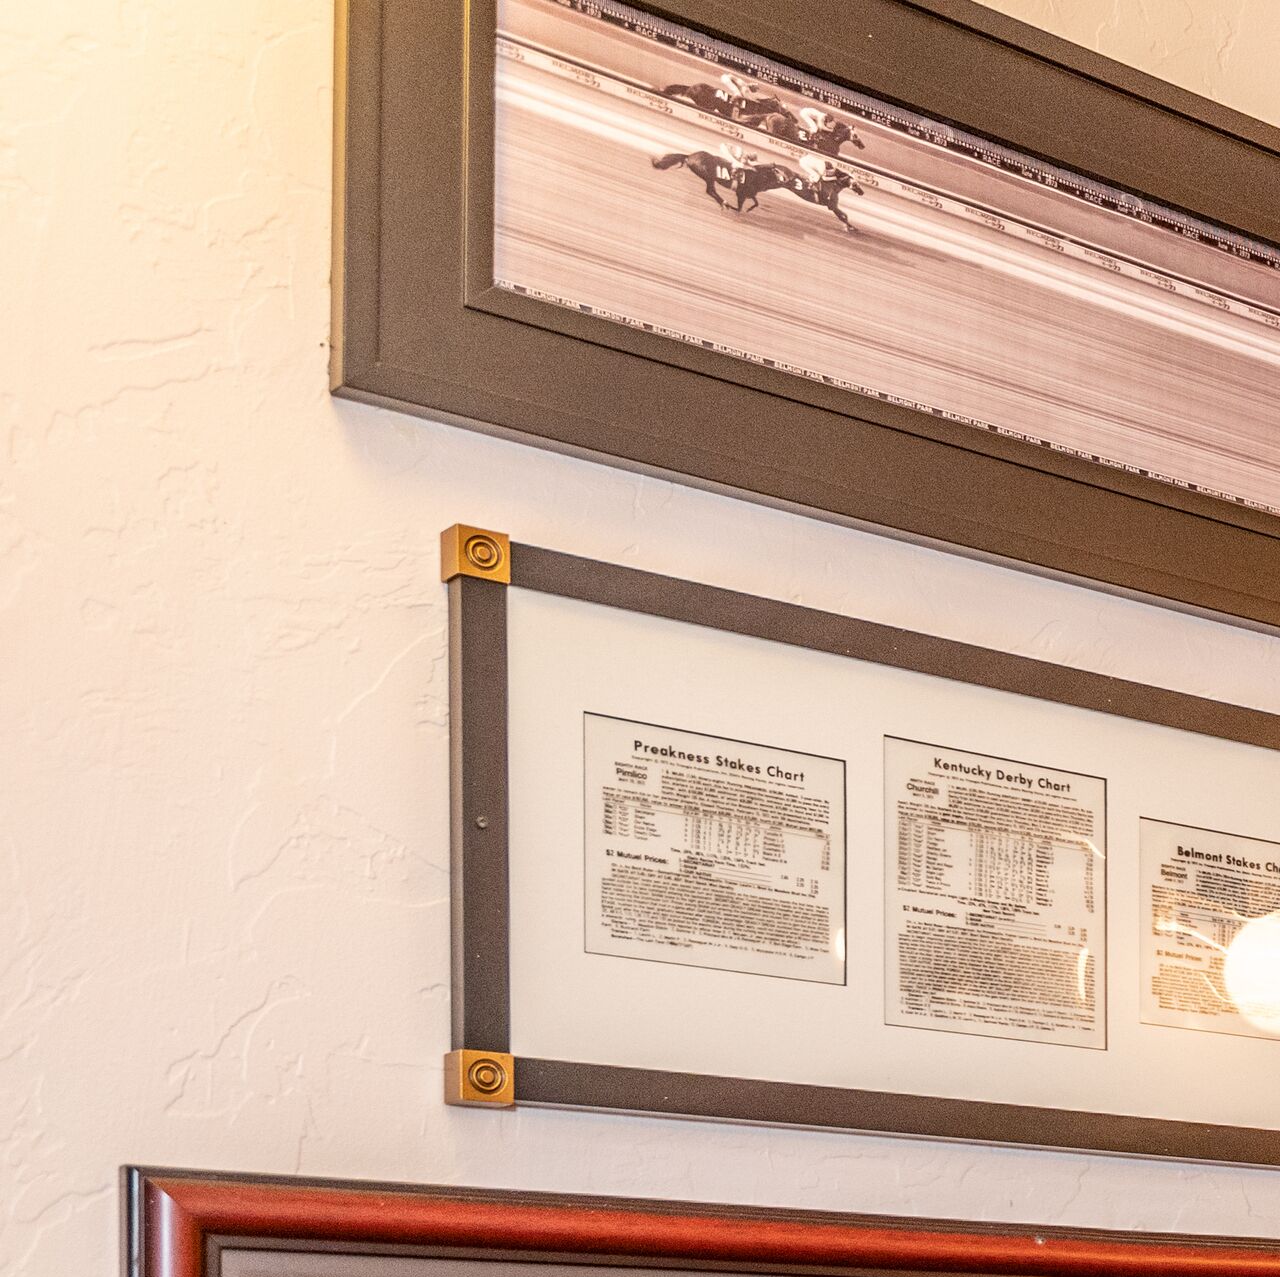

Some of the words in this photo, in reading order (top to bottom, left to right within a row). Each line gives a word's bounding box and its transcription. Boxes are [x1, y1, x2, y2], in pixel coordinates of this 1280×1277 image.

[795, 178, 803, 191] 3
[634, 740, 709, 765] Preakness
[716, 755, 761, 775] Stakes
[767, 765, 805, 782] Chart
[616, 767, 648, 780] Pimlico
[934, 758, 992, 781] Kentucky
[996, 769, 1033, 789] Derby
[1038, 777, 1071, 793] Chart
[906, 782, 940, 795] Churchill
[1177, 846, 1223, 863] Belmont
[1225, 855, 1261, 870] Stakes
[1161, 869, 1188, 880] Belmont
